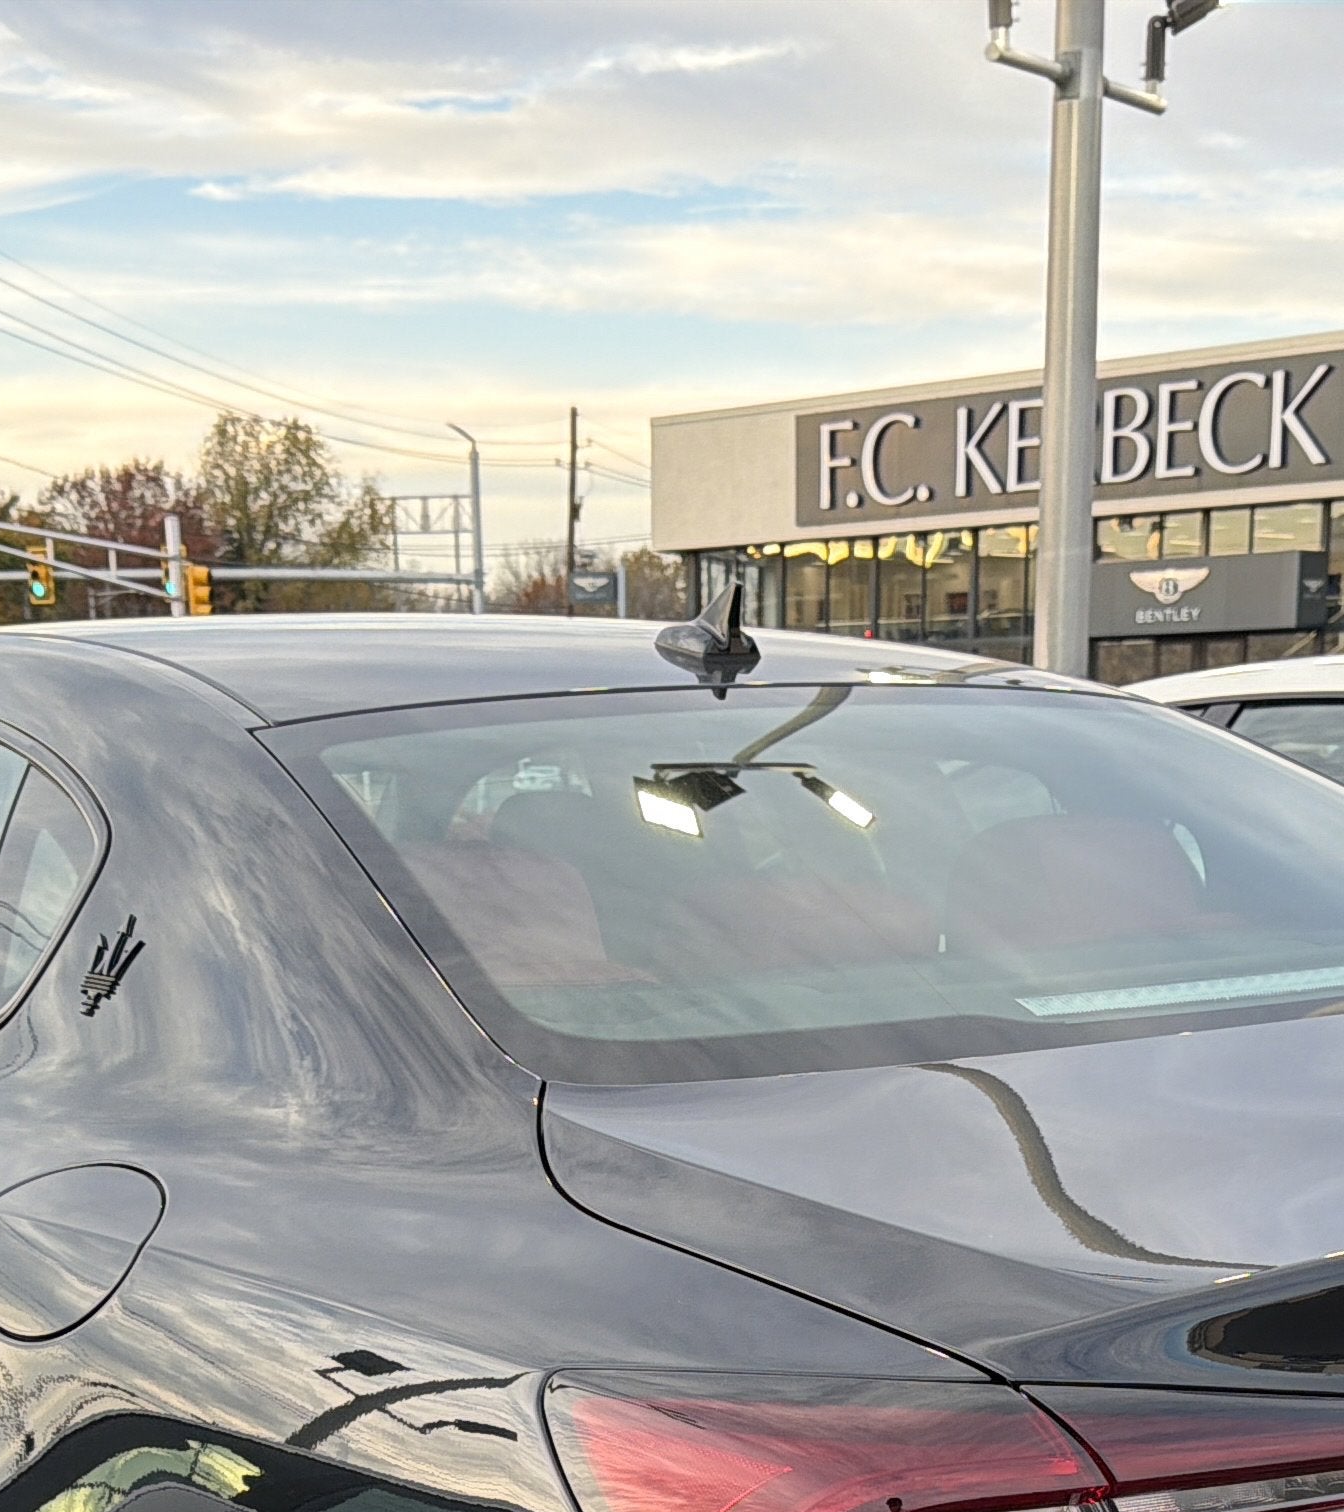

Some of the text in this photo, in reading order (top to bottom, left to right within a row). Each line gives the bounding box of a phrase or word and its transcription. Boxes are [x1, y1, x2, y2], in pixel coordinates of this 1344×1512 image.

[819, 413, 930, 509] F.C.
[955, 364, 1331, 497] KEBECK
[1135, 606, 1201, 624] BENTLEY
